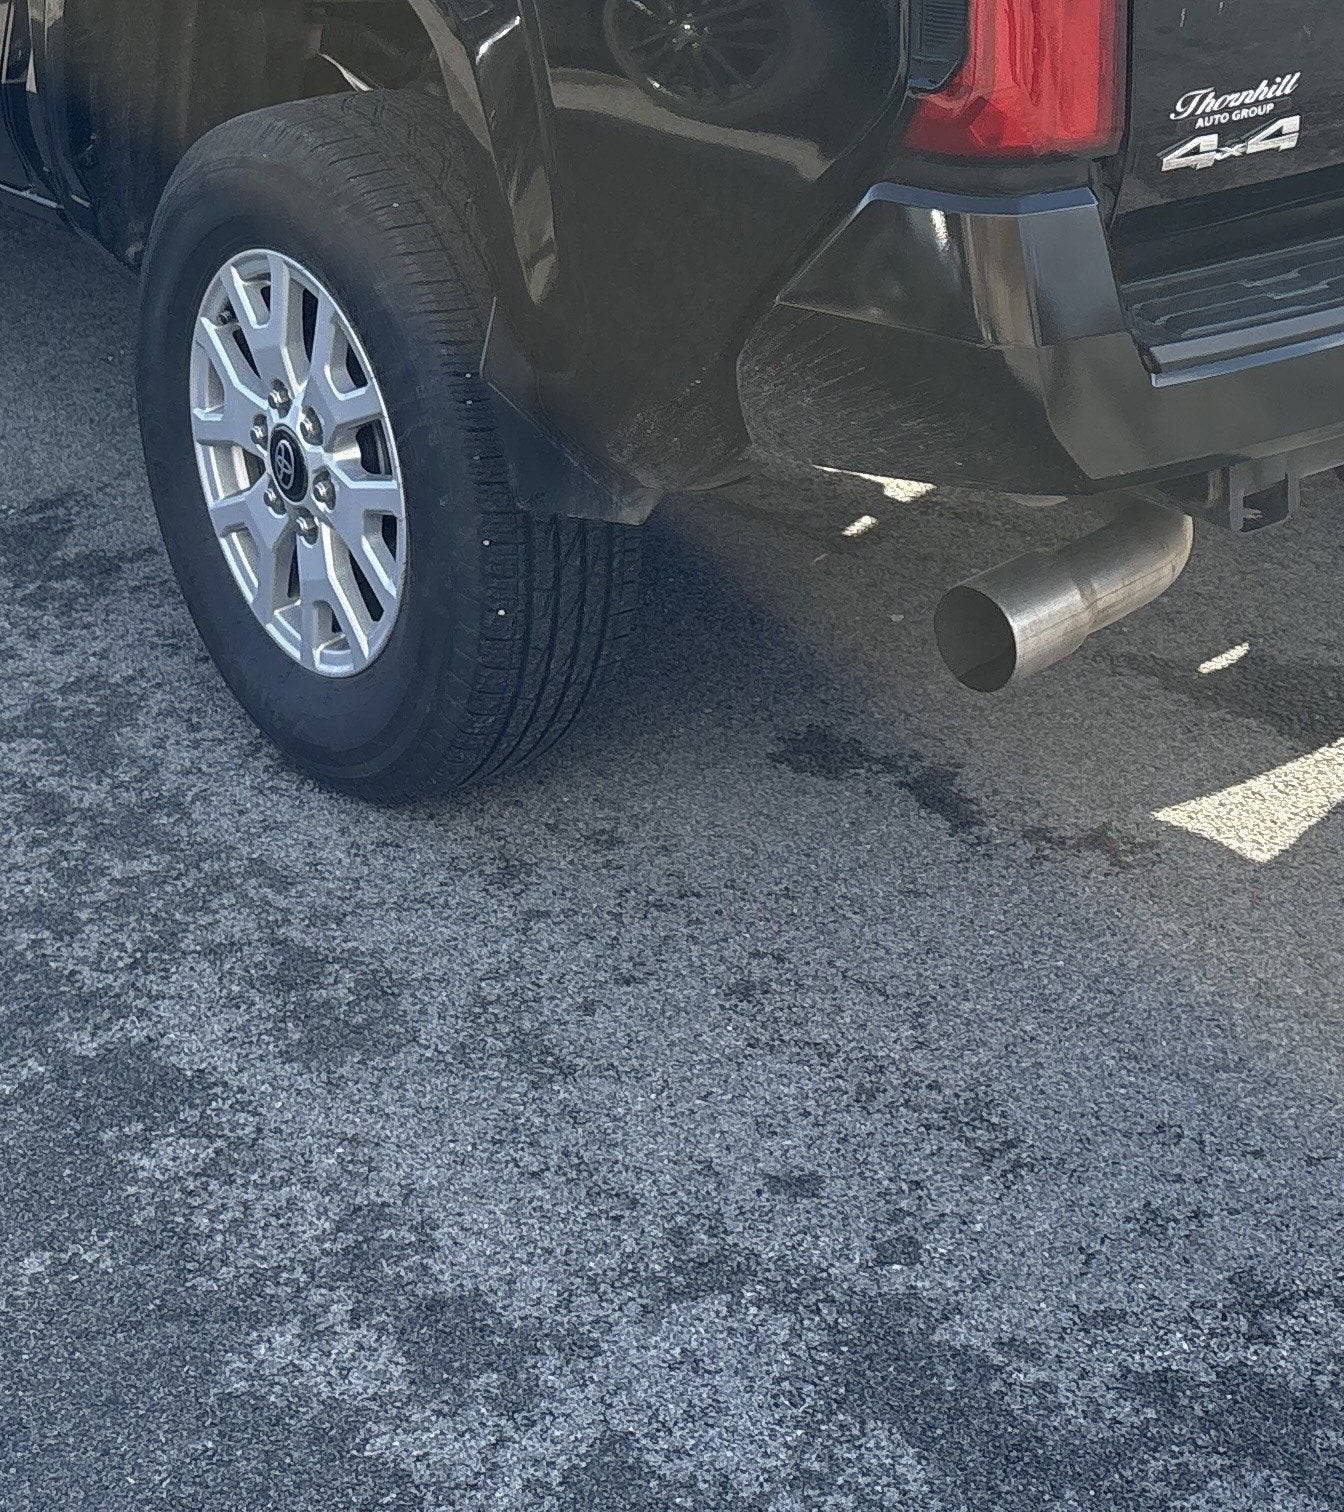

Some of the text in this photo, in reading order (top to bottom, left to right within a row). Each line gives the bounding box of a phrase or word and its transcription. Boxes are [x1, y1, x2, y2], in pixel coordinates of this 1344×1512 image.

[1170, 72, 1301, 120] Thornhill
[1195, 103, 1275, 130] AUTO GROUP
